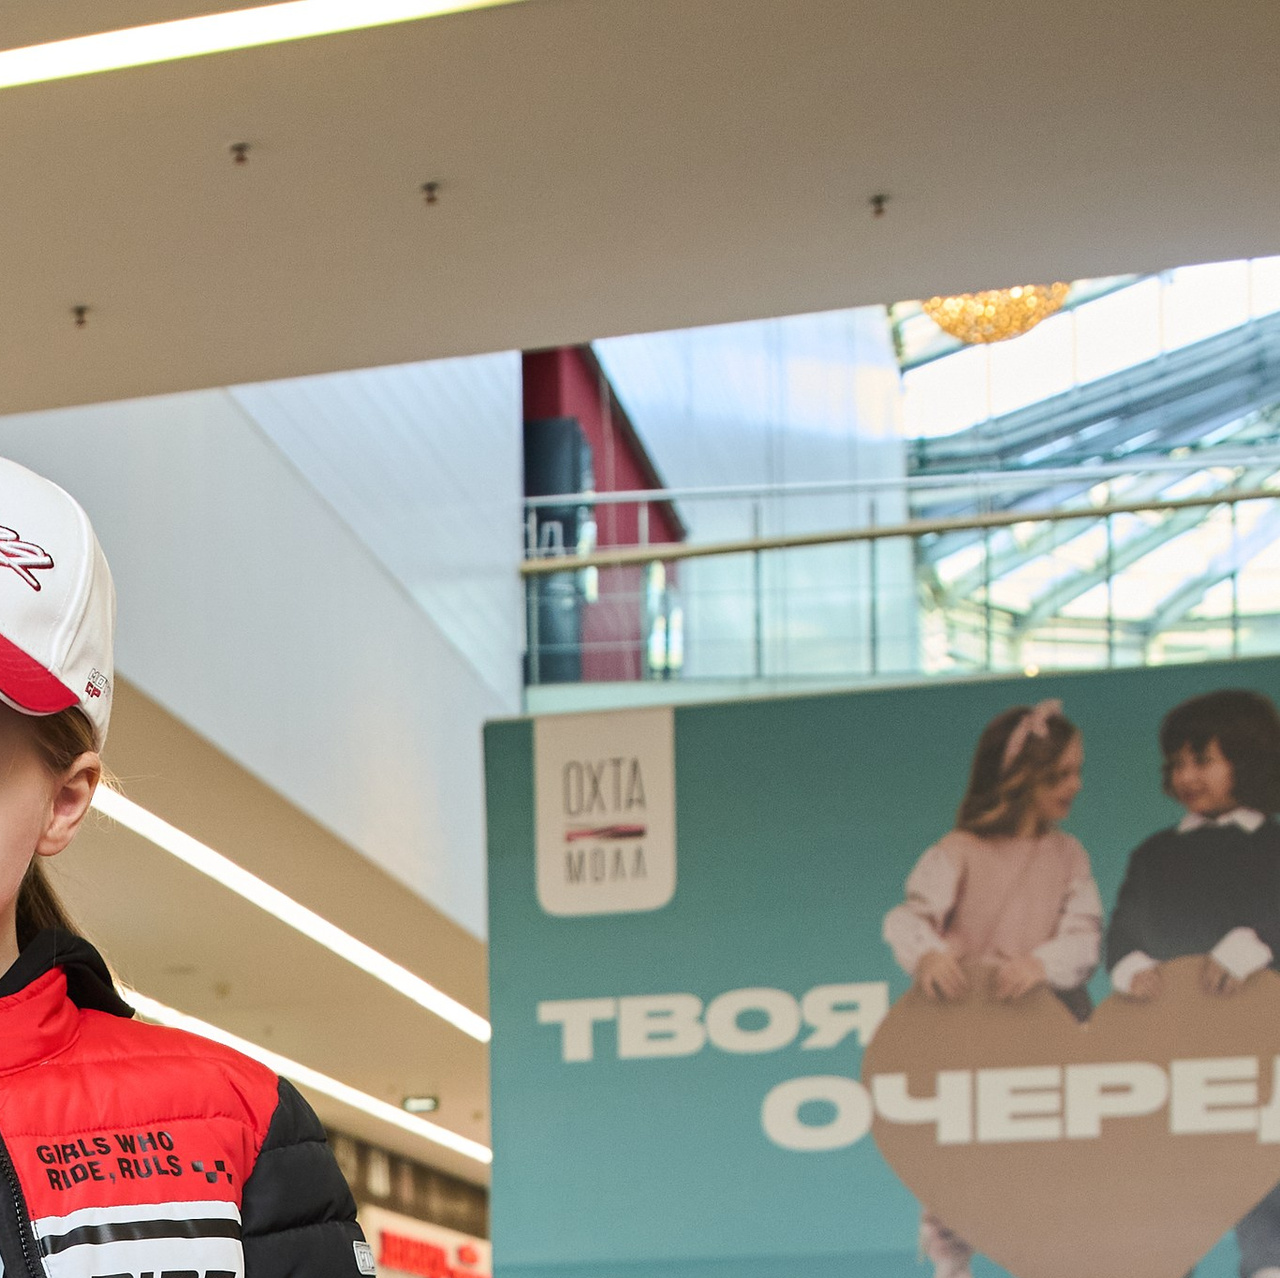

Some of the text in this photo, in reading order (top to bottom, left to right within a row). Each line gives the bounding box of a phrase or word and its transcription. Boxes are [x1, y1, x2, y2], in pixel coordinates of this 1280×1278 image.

[562, 757, 646, 817] ОХТА
[537, 981, 890, 1063] ТВОЯ
[761, 1055, 1280, 1151] ОЧЕРЕ
[36, 1130, 175, 1165] GIRLS WHO
[117, 1154, 183, 1180] RULS
